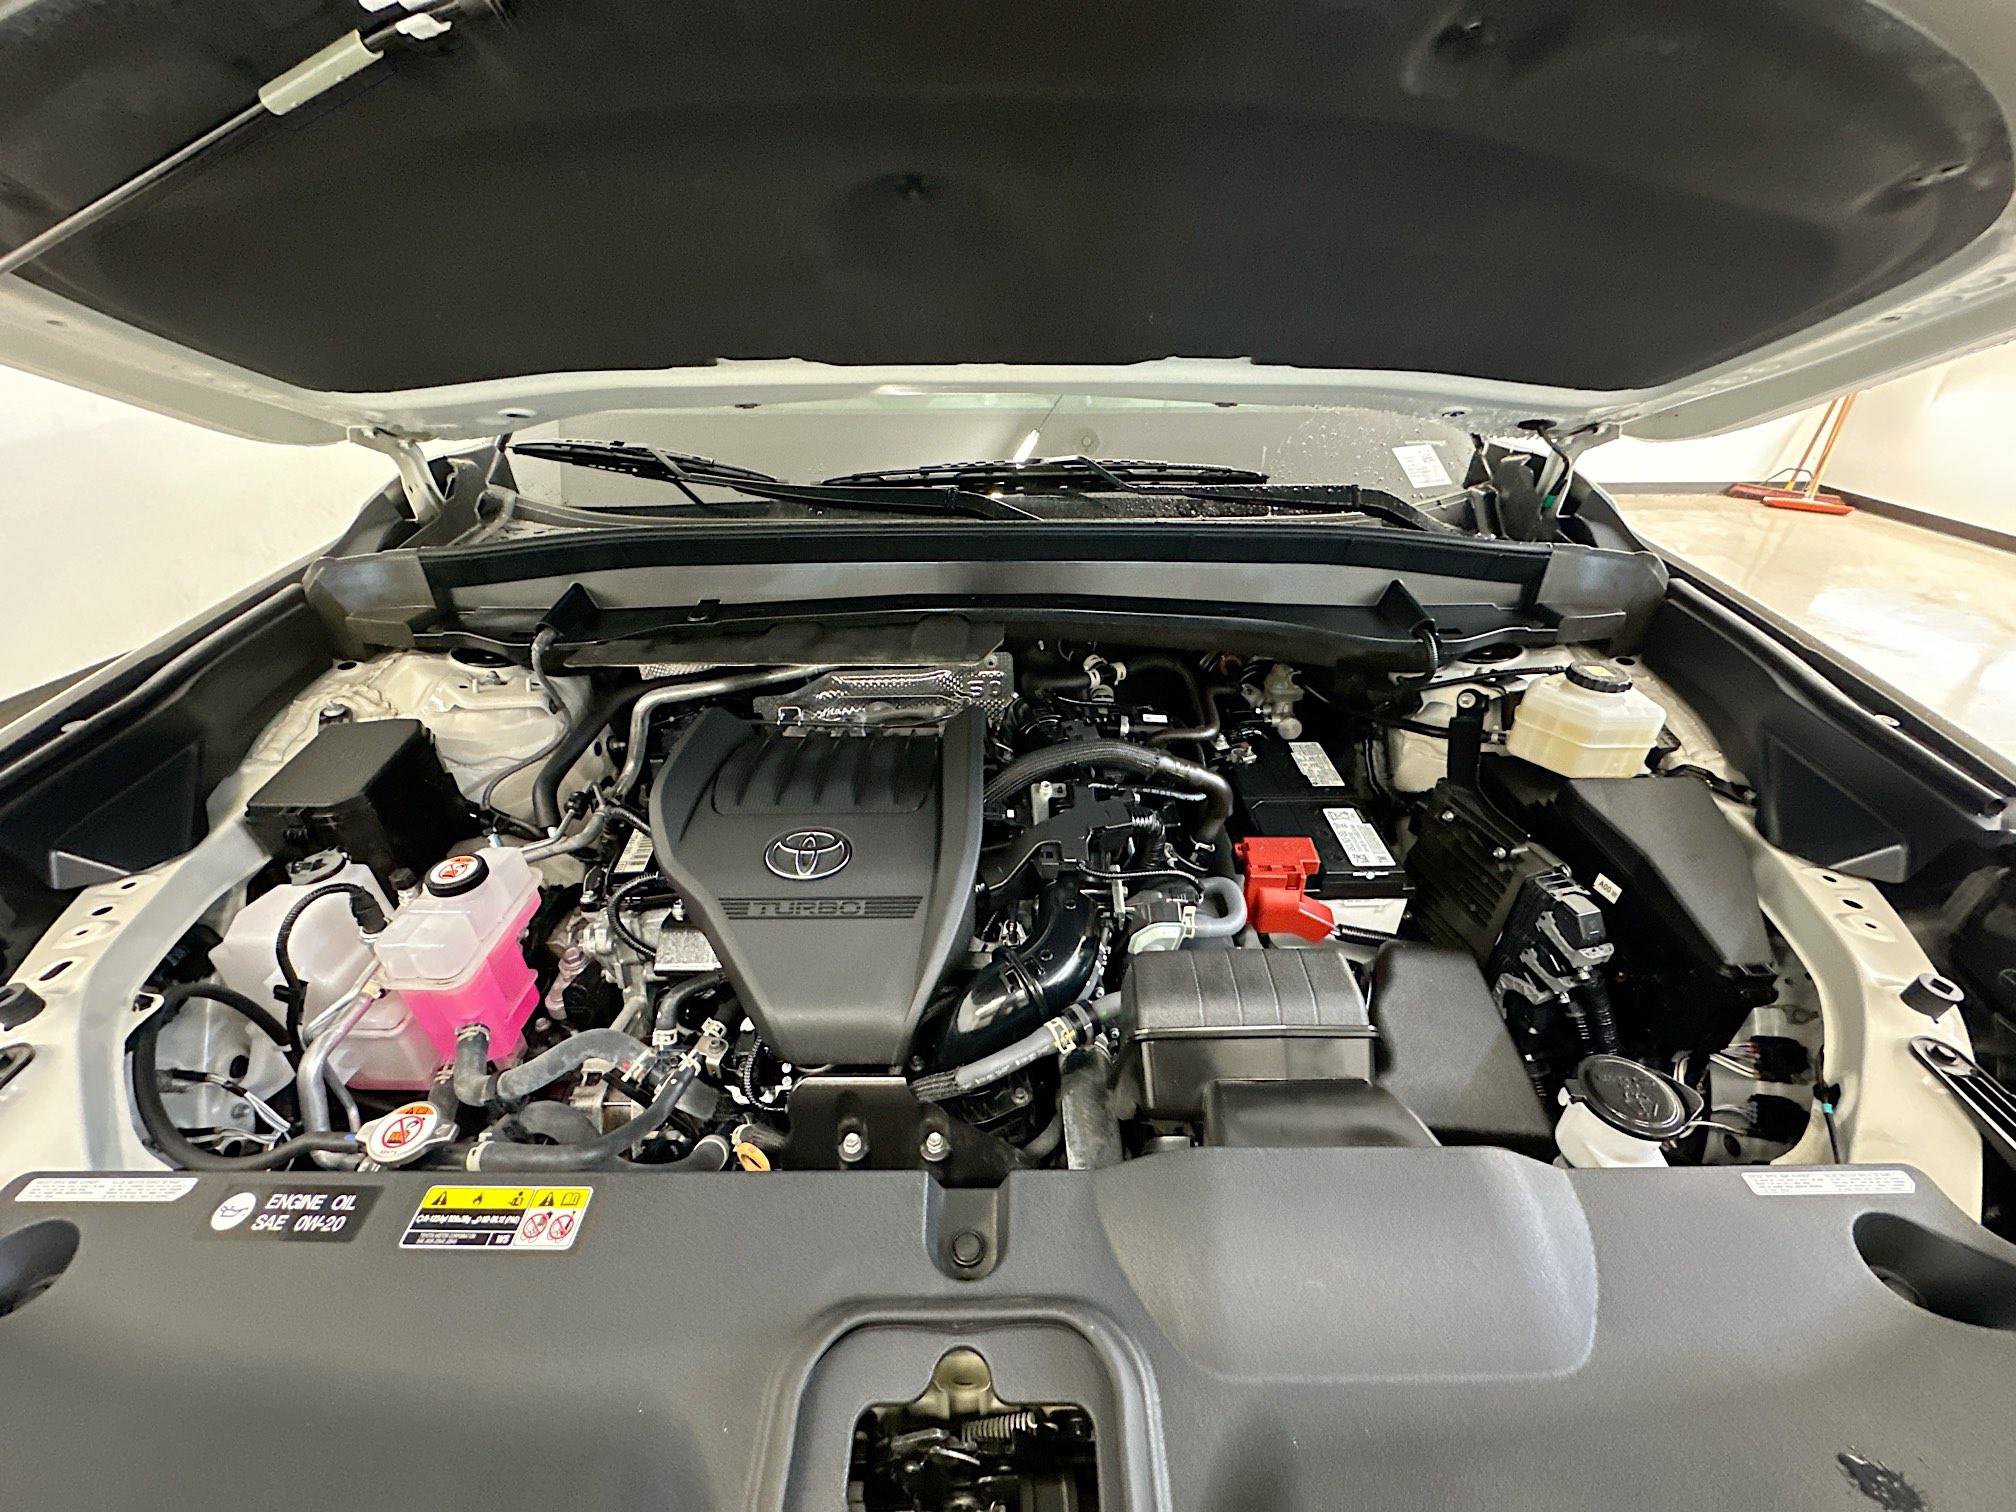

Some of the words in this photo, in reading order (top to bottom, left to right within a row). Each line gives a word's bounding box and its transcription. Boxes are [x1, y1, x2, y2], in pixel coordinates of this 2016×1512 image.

[752, 901, 861, 915] TURBO
[264, 1193, 328, 1210] ENGINE
[330, 1194, 357, 1211] OIL
[251, 1213, 290, 1231] SAE
[293, 1214, 347, 1232] 0W-20
